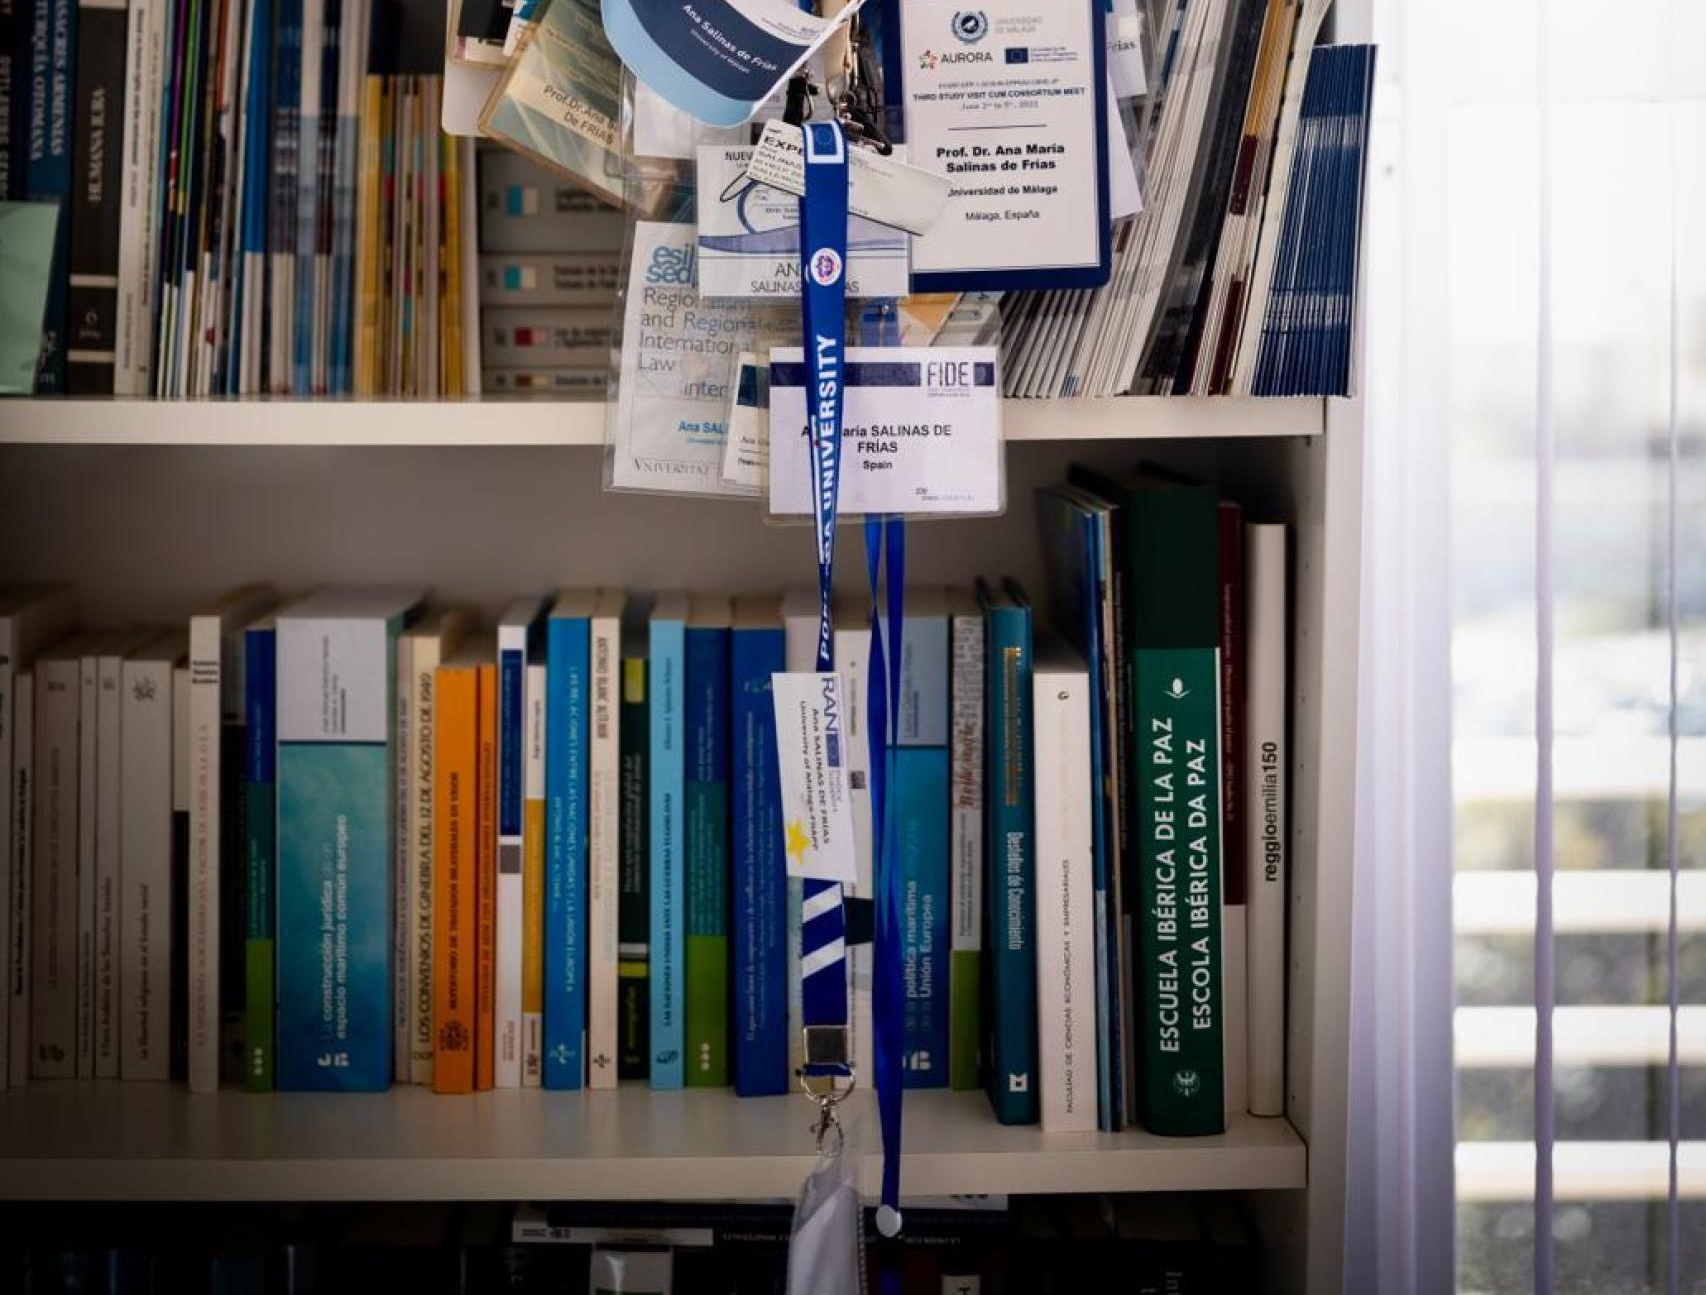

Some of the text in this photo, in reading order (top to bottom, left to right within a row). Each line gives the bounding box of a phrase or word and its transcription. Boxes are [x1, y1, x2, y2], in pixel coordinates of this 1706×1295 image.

[683, 5, 701, 23] Ana
[941, 51, 993, 64] AURORA
[763, 135, 803, 156] EXP
[936, 146, 969, 158] Prof.
[972, 146, 991, 157] Dr.
[995, 145, 1022, 156] Ana
[946, 160, 997, 173] Salinas
[1001, 160, 1018, 172] de
[1007, 186, 1020, 195] de
[1004, 209, 1040, 222] España
[774, 263, 801, 278] AN
[751, 281, 802, 294] SALINAS
[640, 312, 675, 328] and
[638, 352, 676, 372] Law
[926, 360, 970, 387] FIDE
[815, 333, 839, 512] UNIVERSITY
[870, 423, 931, 437] SALINAS
[933, 423, 953, 436] DE
[857, 438, 899, 455] FRÍAS
[862, 460, 893, 472] Spain
[820, 676, 839, 735] RAN
[811, 708, 821, 733] Ana
[813, 735, 825, 787] SALINAS
[1260, 741, 1281, 883] reggioemilia150
[1061, 859, 1070, 927] EMPRESARIALES
[1152, 717, 1179, 1052] ESCUELA IBÉRICA DE LA PAZ
[1184, 738, 1212, 1030] ESCOLA IBÉRICA DA PAZ
[918, 894, 934, 954] Europea
[1063, 1008, 1073, 1051] CIENCIAS
[1064, 1052, 1073, 1067] DE
[1064, 1069, 1073, 1114] FACULTAD
